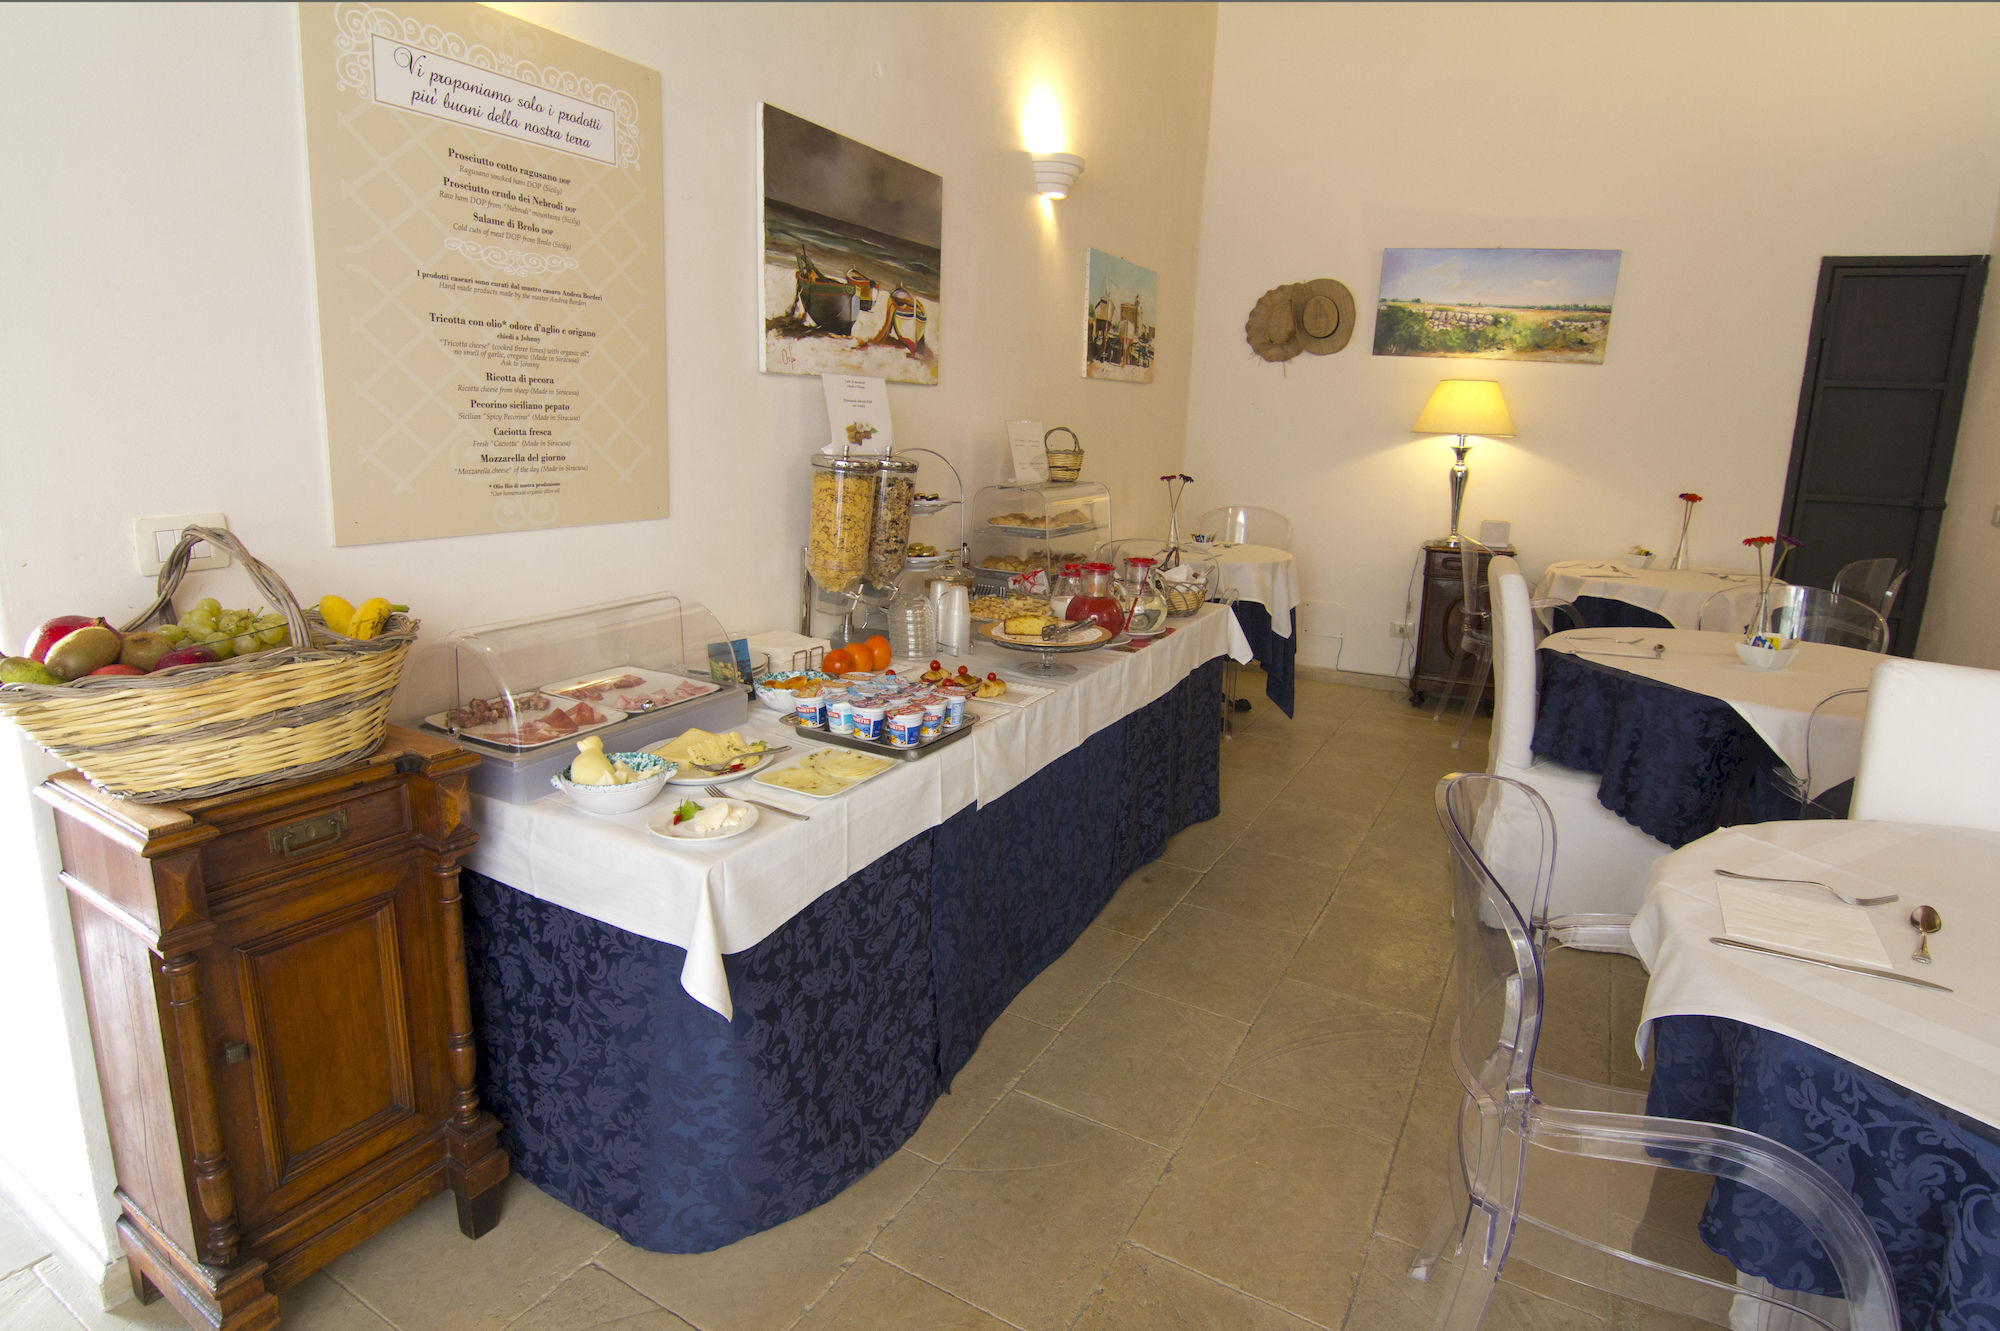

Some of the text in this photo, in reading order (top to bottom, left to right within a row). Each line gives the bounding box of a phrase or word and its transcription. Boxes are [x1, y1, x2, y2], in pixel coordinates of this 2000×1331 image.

[393, 47, 602, 131] Vi proponiamo solo i prodotti
[443, 92, 483, 118] buoni
[487, 106, 520, 129] della
[524, 122, 562, 140] nostra
[565, 132, 591, 148] terra
[449, 148, 494, 167] Prosciutto
[496, 163, 518, 172] cotto
[520, 168, 557, 182] ragusano
[444, 177, 489, 194] Prosciutto
[492, 190, 516, 200] crudo
[518, 193, 530, 203] dei
[533, 196, 563, 210] Nebrodi
[473, 212, 504, 226] Salame
[507, 219, 514, 228] di
[518, 221, 540, 232] Brolo
[422, 272, 449, 280] prodotti
[510, 282, 520, 290] dal
[562, 290, 582, 298] Andrea
[583, 292, 602, 300] Borderi
[429, 313, 466, 324] Tricotta
[510, 321, 532, 331] odore
[568, 328, 596, 338] origano
[497, 332, 514, 340] chiedi
[520, 334, 540, 344] Johnny
[486, 372, 516, 382] Ricotta
[519, 374, 526, 382] di
[471, 400, 570, 412] Pecorino siciliano pepato
[494, 427, 552, 436] Caciotta fresca
[481, 453, 566, 464] Mozzarella del giorno
